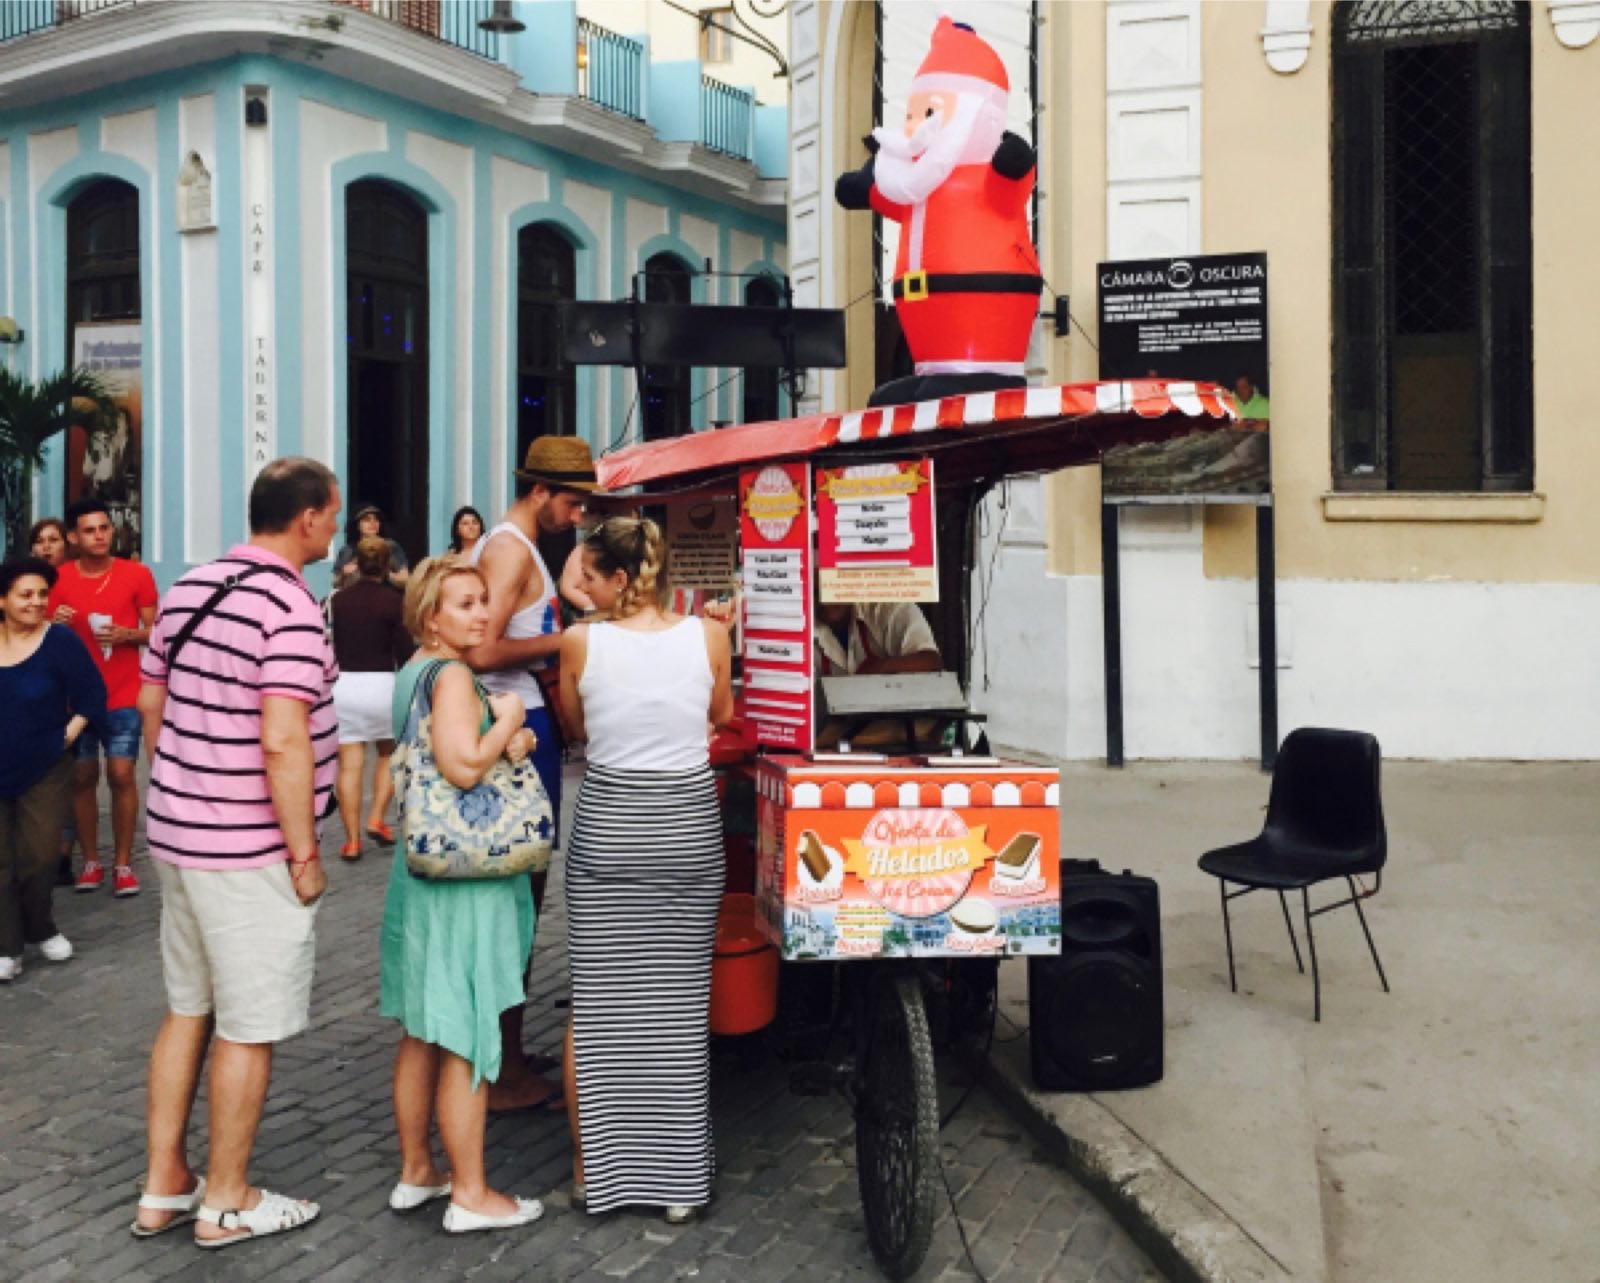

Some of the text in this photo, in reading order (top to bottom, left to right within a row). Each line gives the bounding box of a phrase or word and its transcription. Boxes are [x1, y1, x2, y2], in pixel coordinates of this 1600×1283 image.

[1200, 265, 1264, 282] OSCURA
[255, 337, 268, 461] TABERNA
[875, 819, 931, 844] Oferta
[866, 847, 969, 877] Helados
[907, 880, 954, 898] Cream
